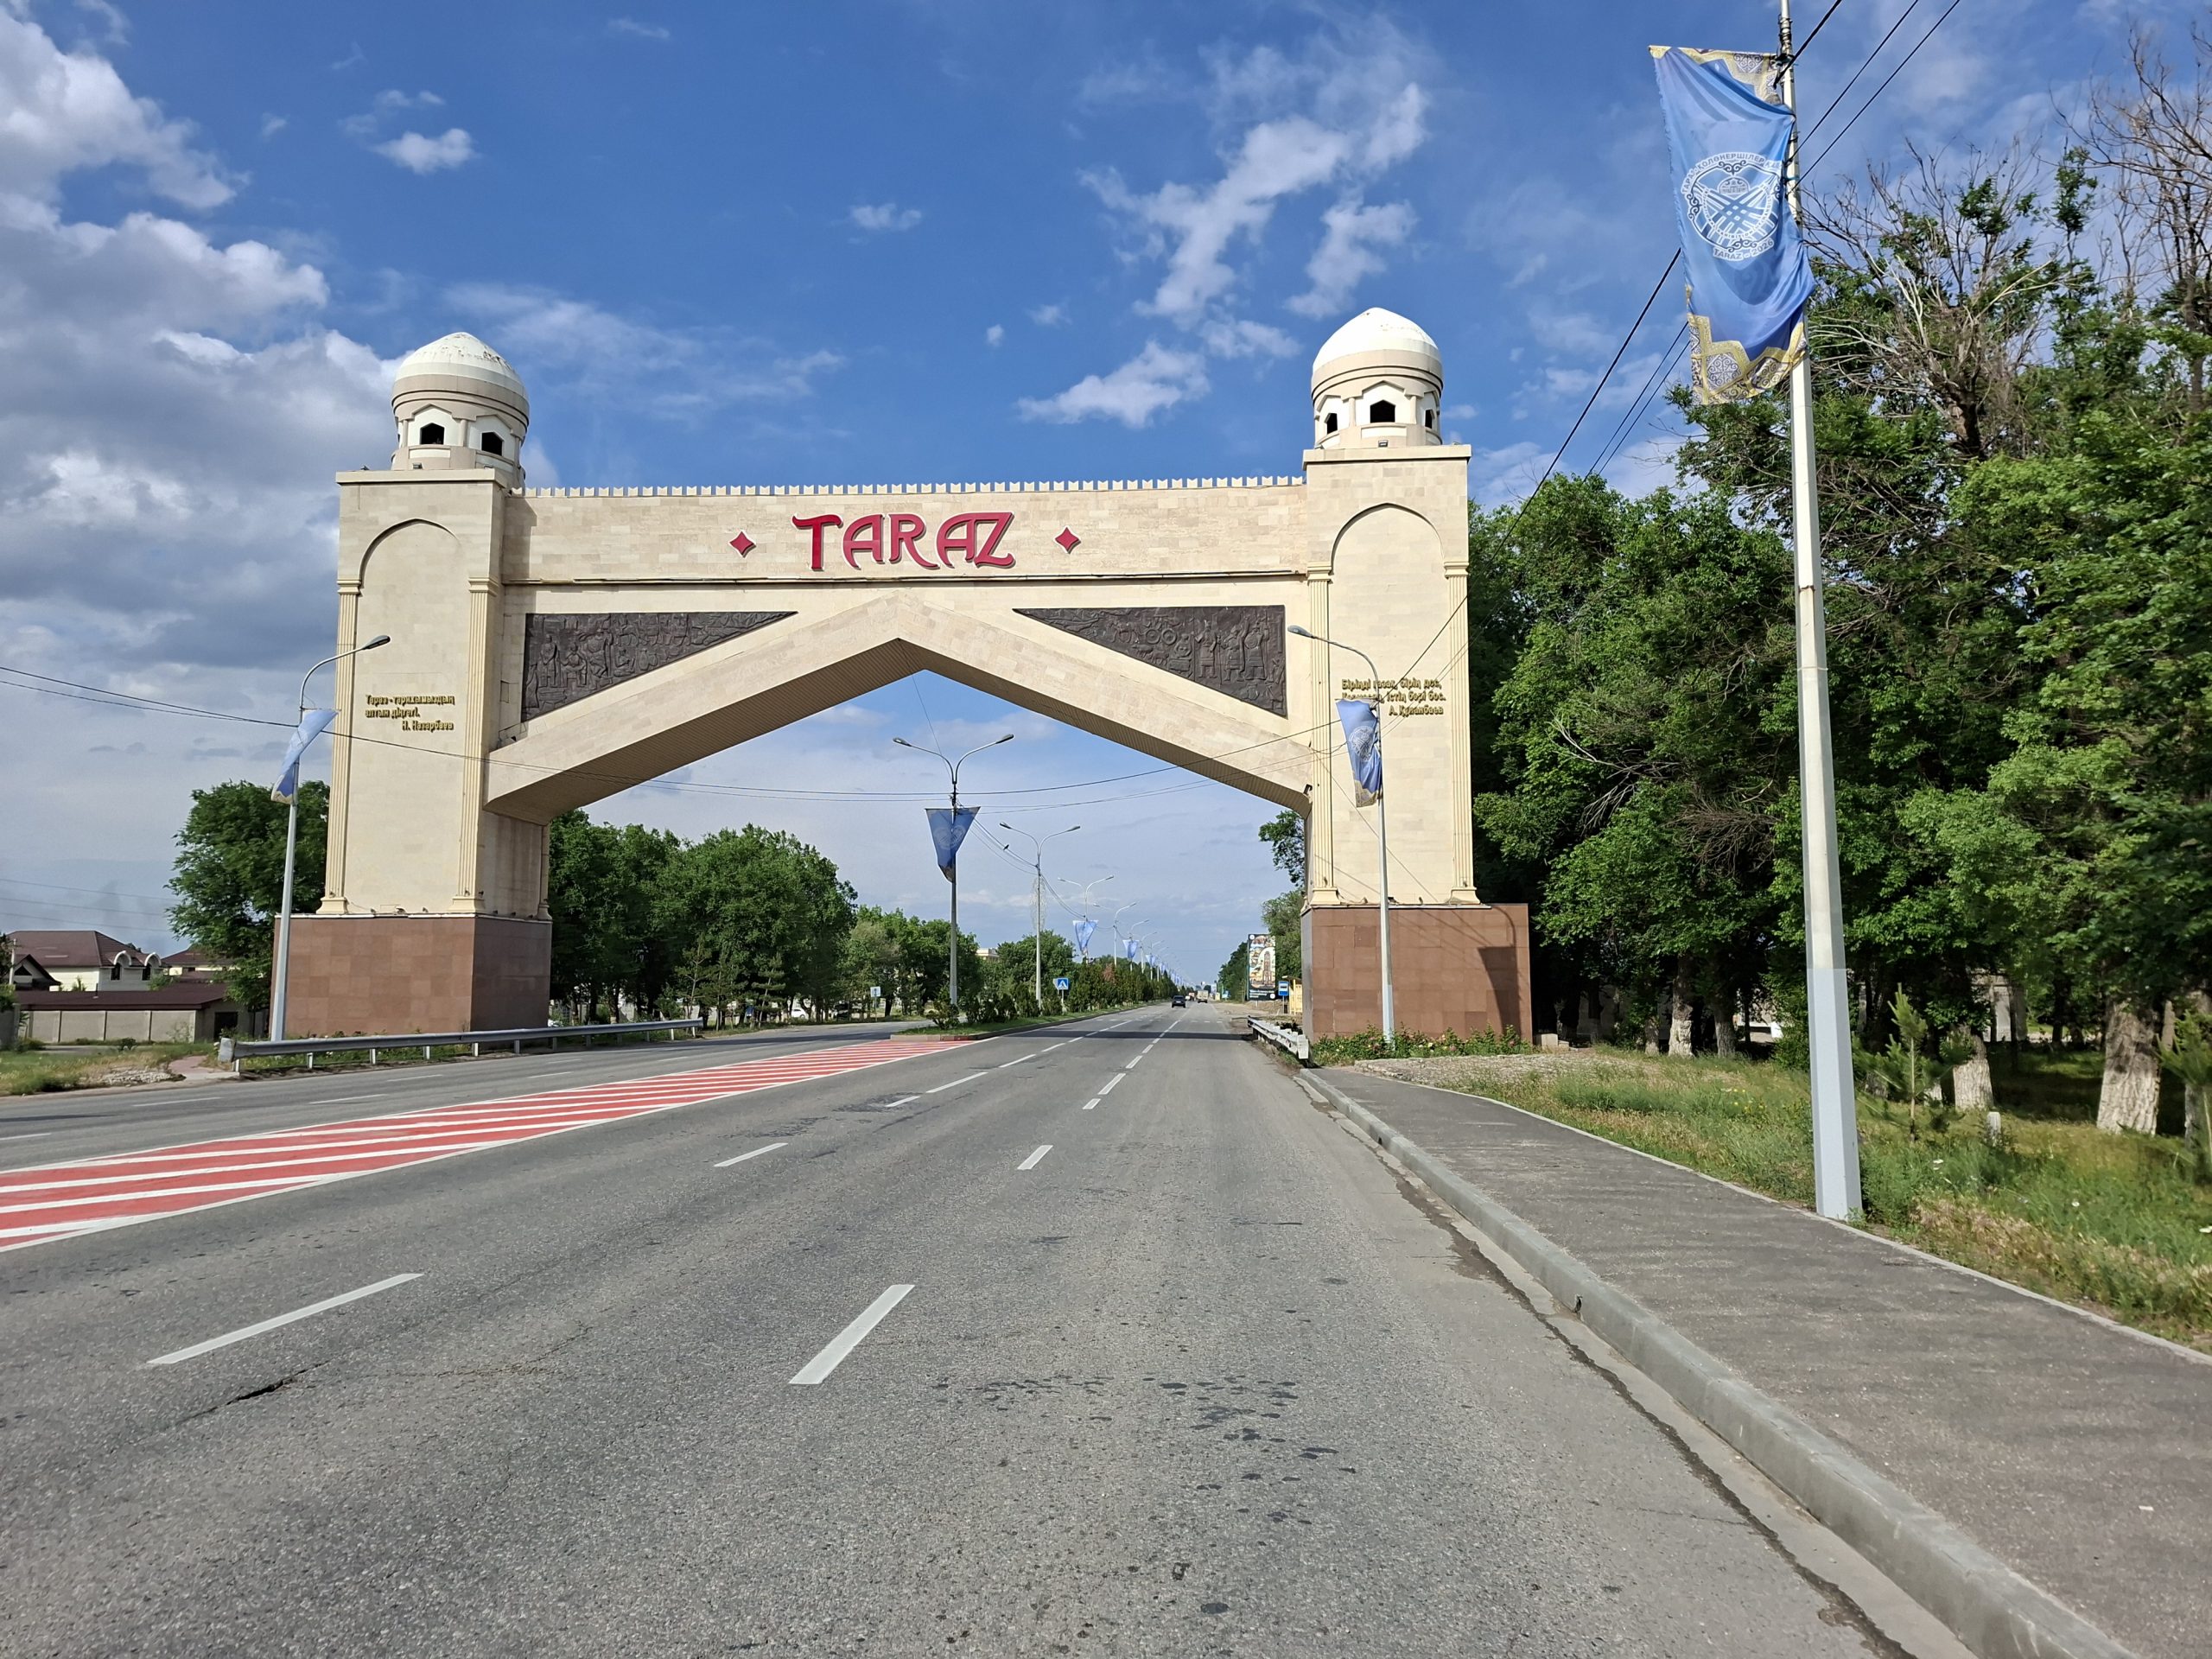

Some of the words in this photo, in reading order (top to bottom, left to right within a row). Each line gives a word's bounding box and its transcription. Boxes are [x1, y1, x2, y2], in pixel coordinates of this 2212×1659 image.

[1714, 248, 1742, 260] TARAZ
[1751, 239, 1773, 255] 2026
[791, 512, 1015, 570] TARAZ
[365, 695, 388, 707] Тараз
[402, 720, 410, 731] Н.
[412, 720, 454, 733] Назарбаев
